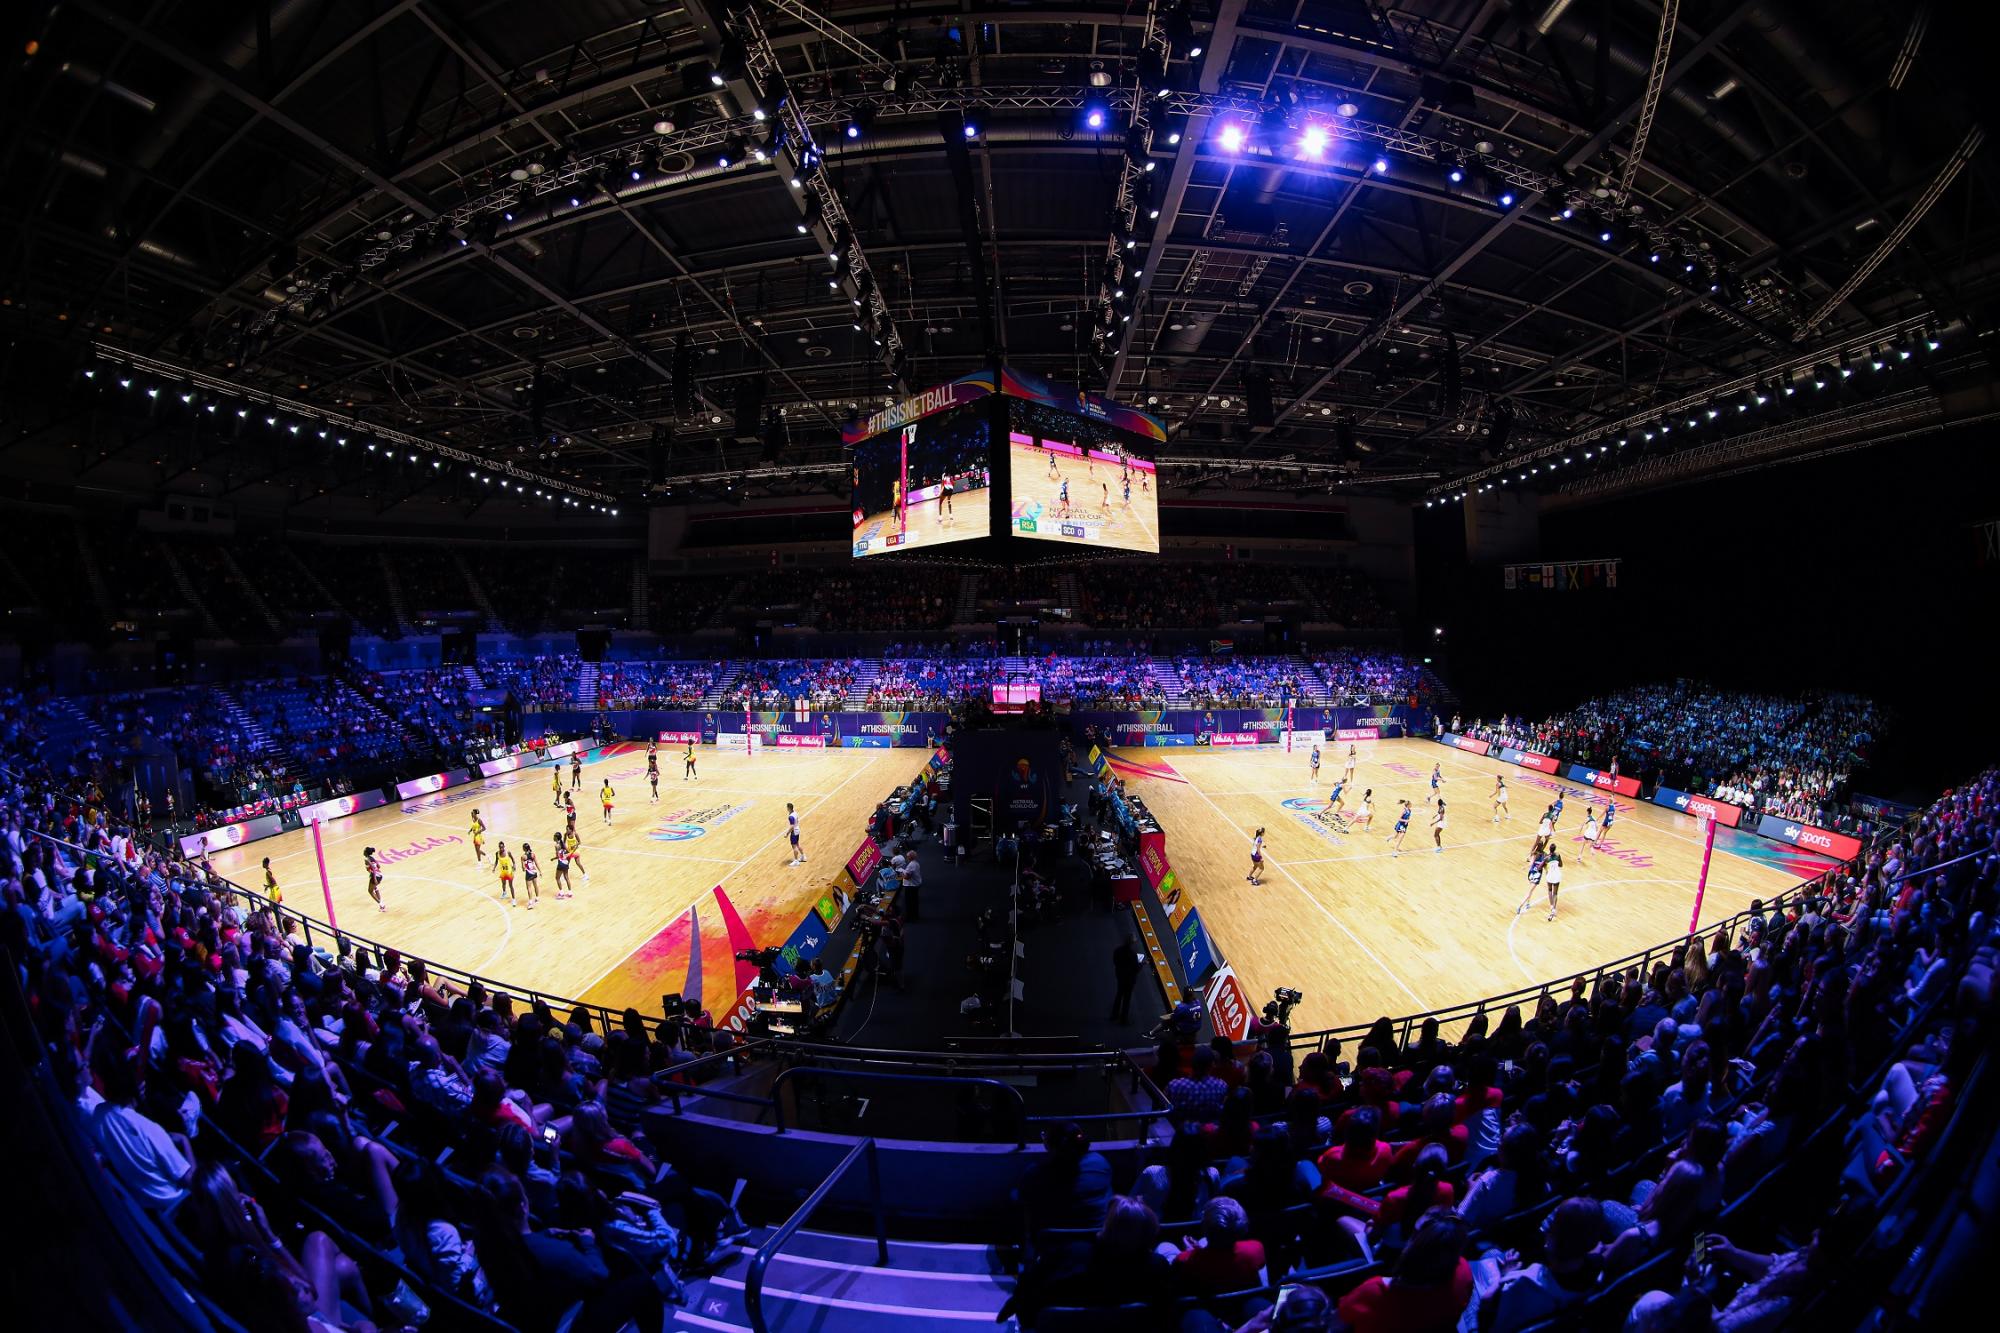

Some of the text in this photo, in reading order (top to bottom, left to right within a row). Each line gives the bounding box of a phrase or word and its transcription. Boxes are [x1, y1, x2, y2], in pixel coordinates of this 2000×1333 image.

[868, 383, 957, 434] #THISISNETBALL
[1022, 520, 1035, 530] RSA
[1063, 526, 1075, 535] SCO
[1356, 717, 1402, 726] #THISISNETBALL
[860, 724, 918, 733] #THISISNETBALL
[1117, 723, 1174, 732] #THISISNETBALL
[661, 732, 679, 743] Vitality
[1213, 733, 1256, 745] Vitality Vitality
[1524, 756, 1541, 766] sports
[1585, 771, 1597, 782] sky
[1676, 795, 1716, 815] sky sports
[1784, 825, 1831, 848] sky sports
[377, 835, 464, 865] Vitality
[708, 1301, 722, 1313] K
